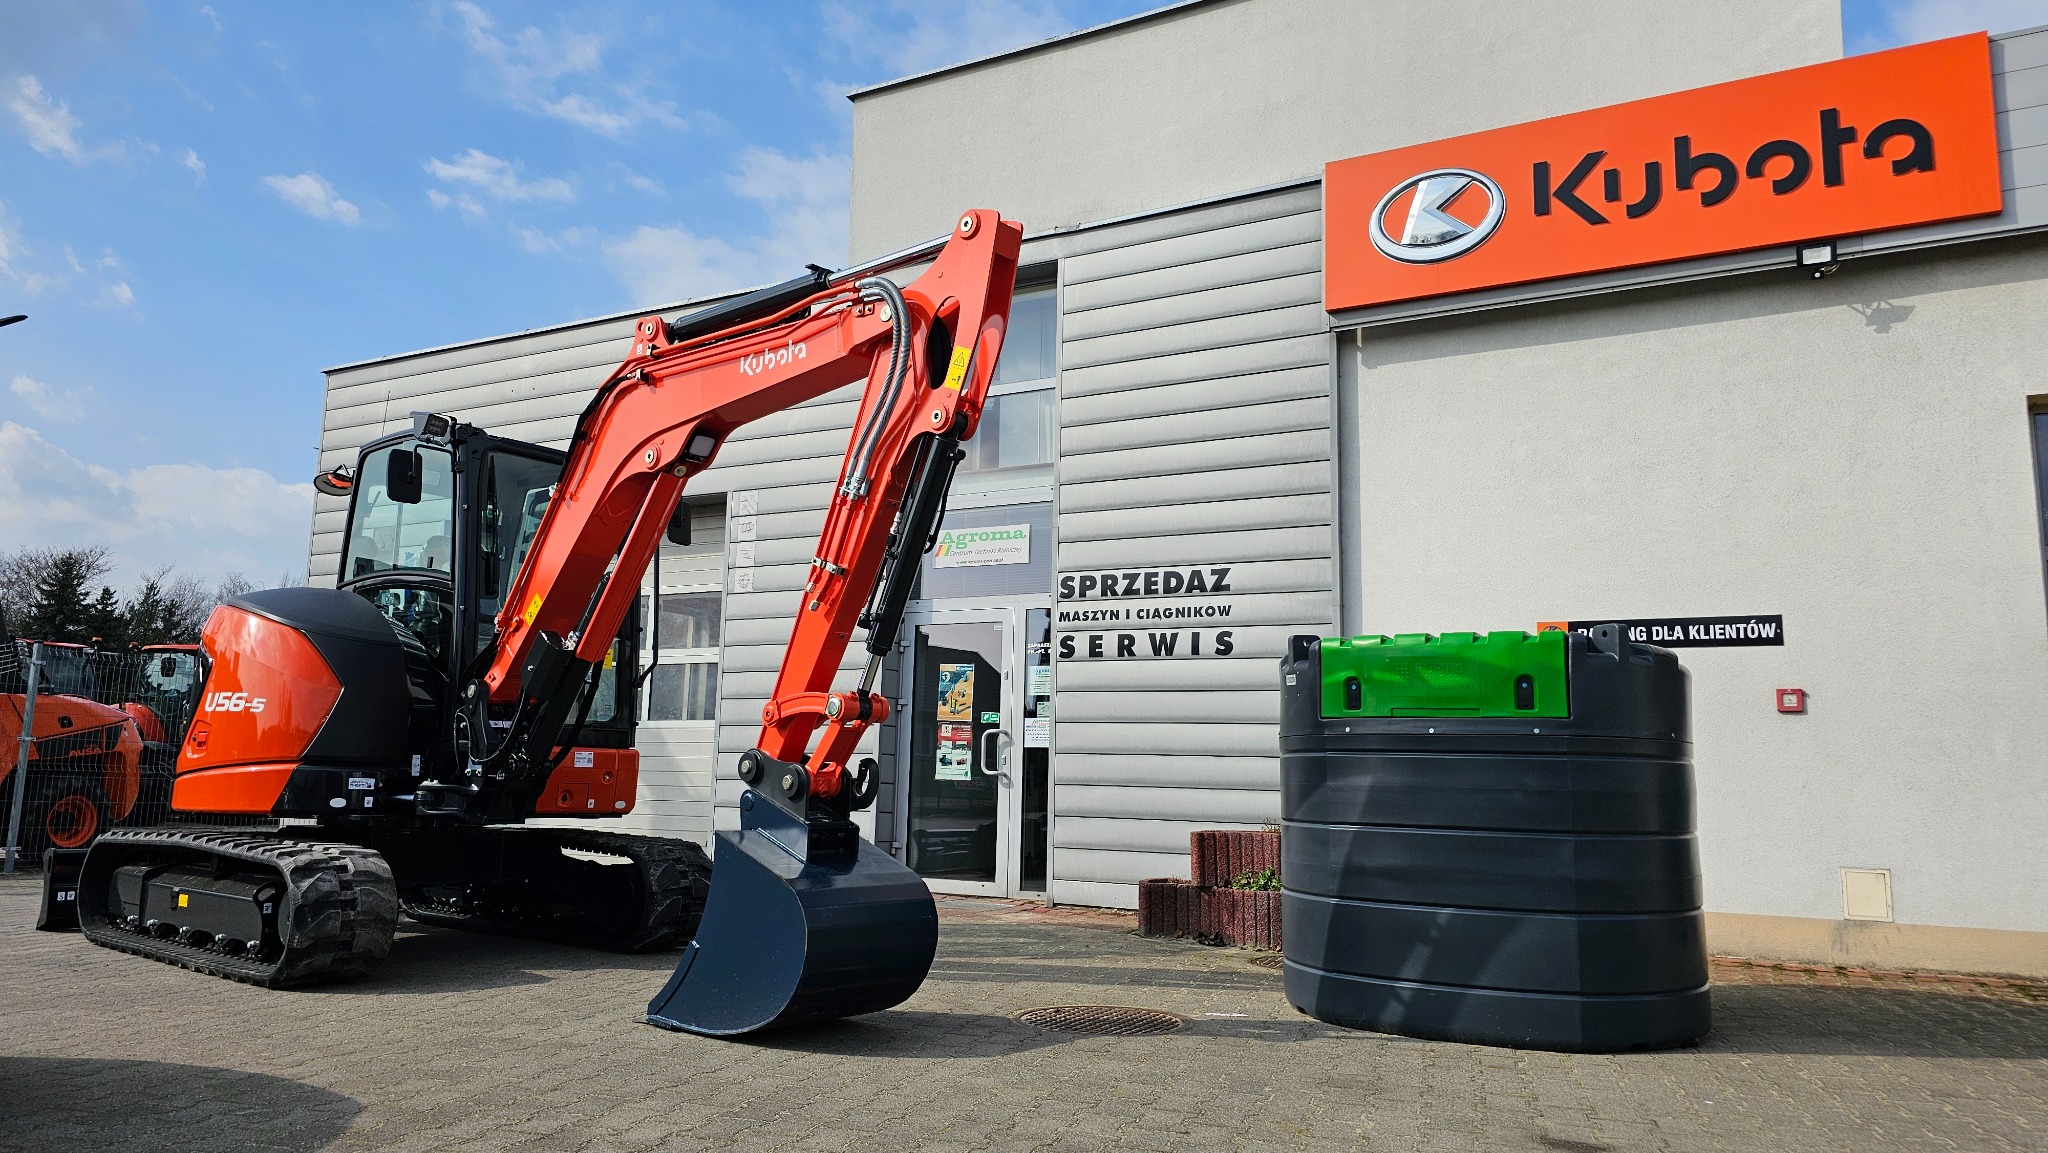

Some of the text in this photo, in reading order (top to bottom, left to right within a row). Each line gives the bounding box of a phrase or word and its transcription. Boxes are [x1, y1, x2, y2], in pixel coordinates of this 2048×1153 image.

[1532, 107, 1936, 225] Kubota
[740, 339, 807, 376] Kubota
[939, 529, 1027, 549] Agroma
[1058, 609, 1120, 623] MASZYN
[1125, 608, 1131, 620] I
[1652, 625, 1683, 642] DLA
[1688, 619, 1777, 640] KLIENTÓW
[1058, 630, 1234, 659] SERWIS
[204, 691, 268, 713] U56-5
